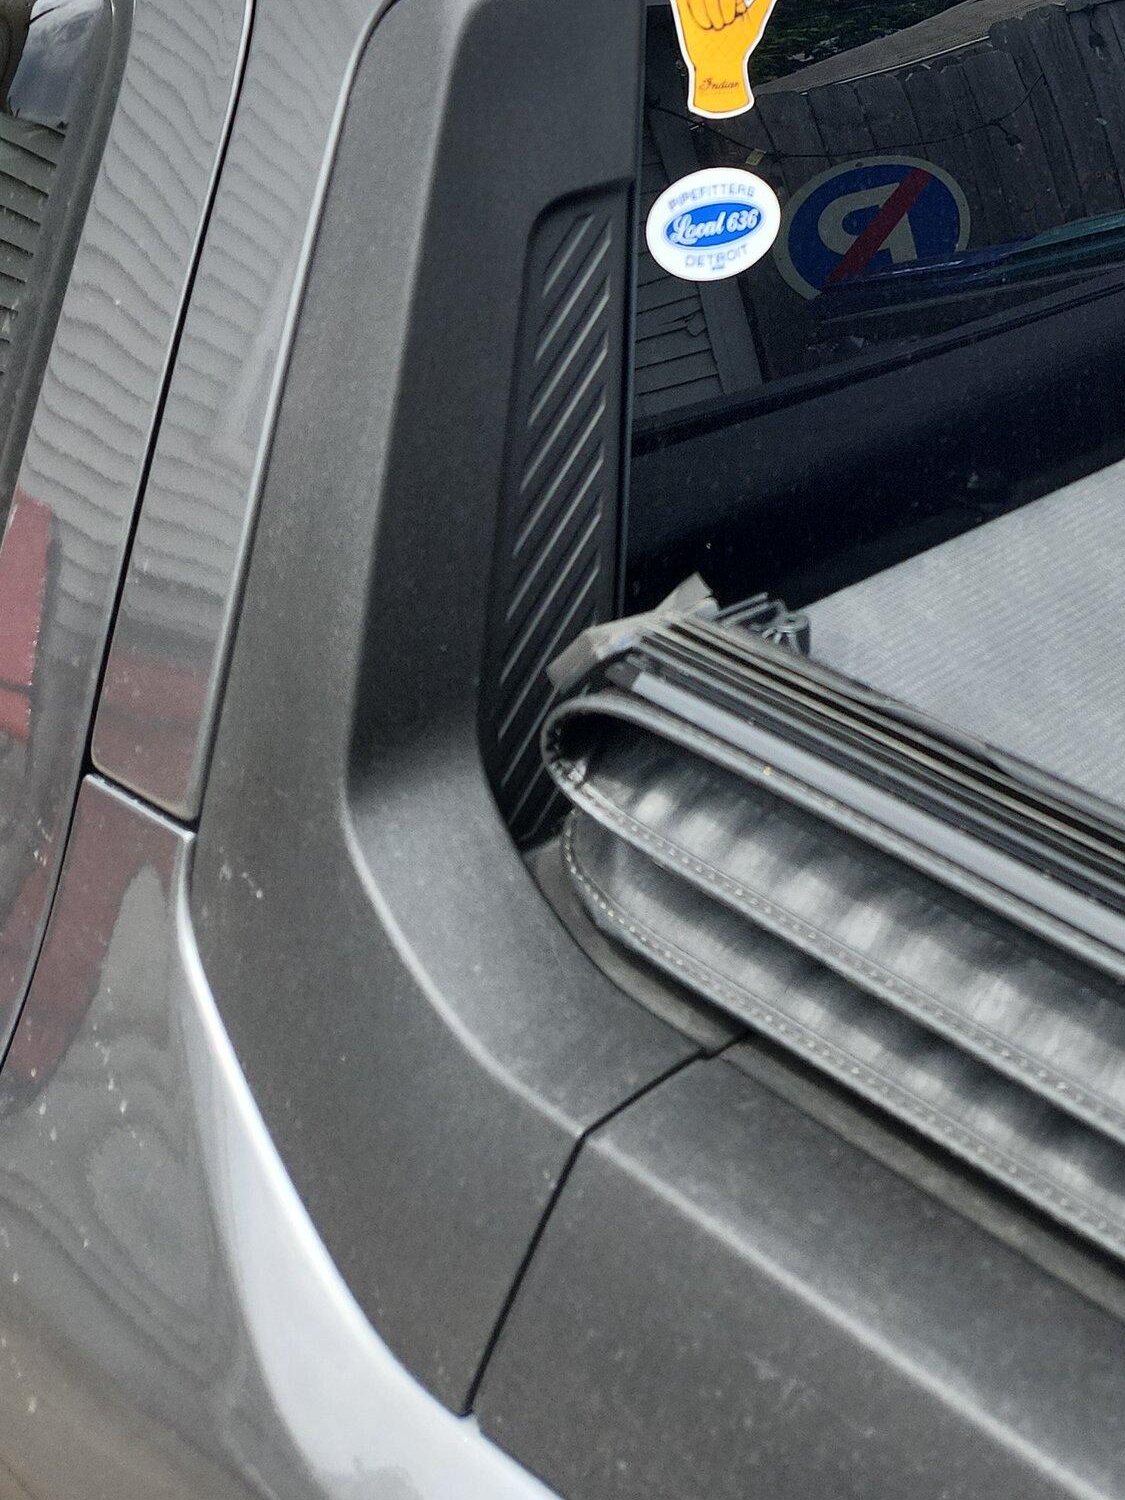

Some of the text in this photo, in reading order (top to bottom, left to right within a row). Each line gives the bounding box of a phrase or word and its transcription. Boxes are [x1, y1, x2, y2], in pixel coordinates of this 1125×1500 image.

[667, 182, 757, 211] PIPEFITTERS
[669, 208, 760, 246] Local 636
[684, 244, 748, 269] DETROIT
